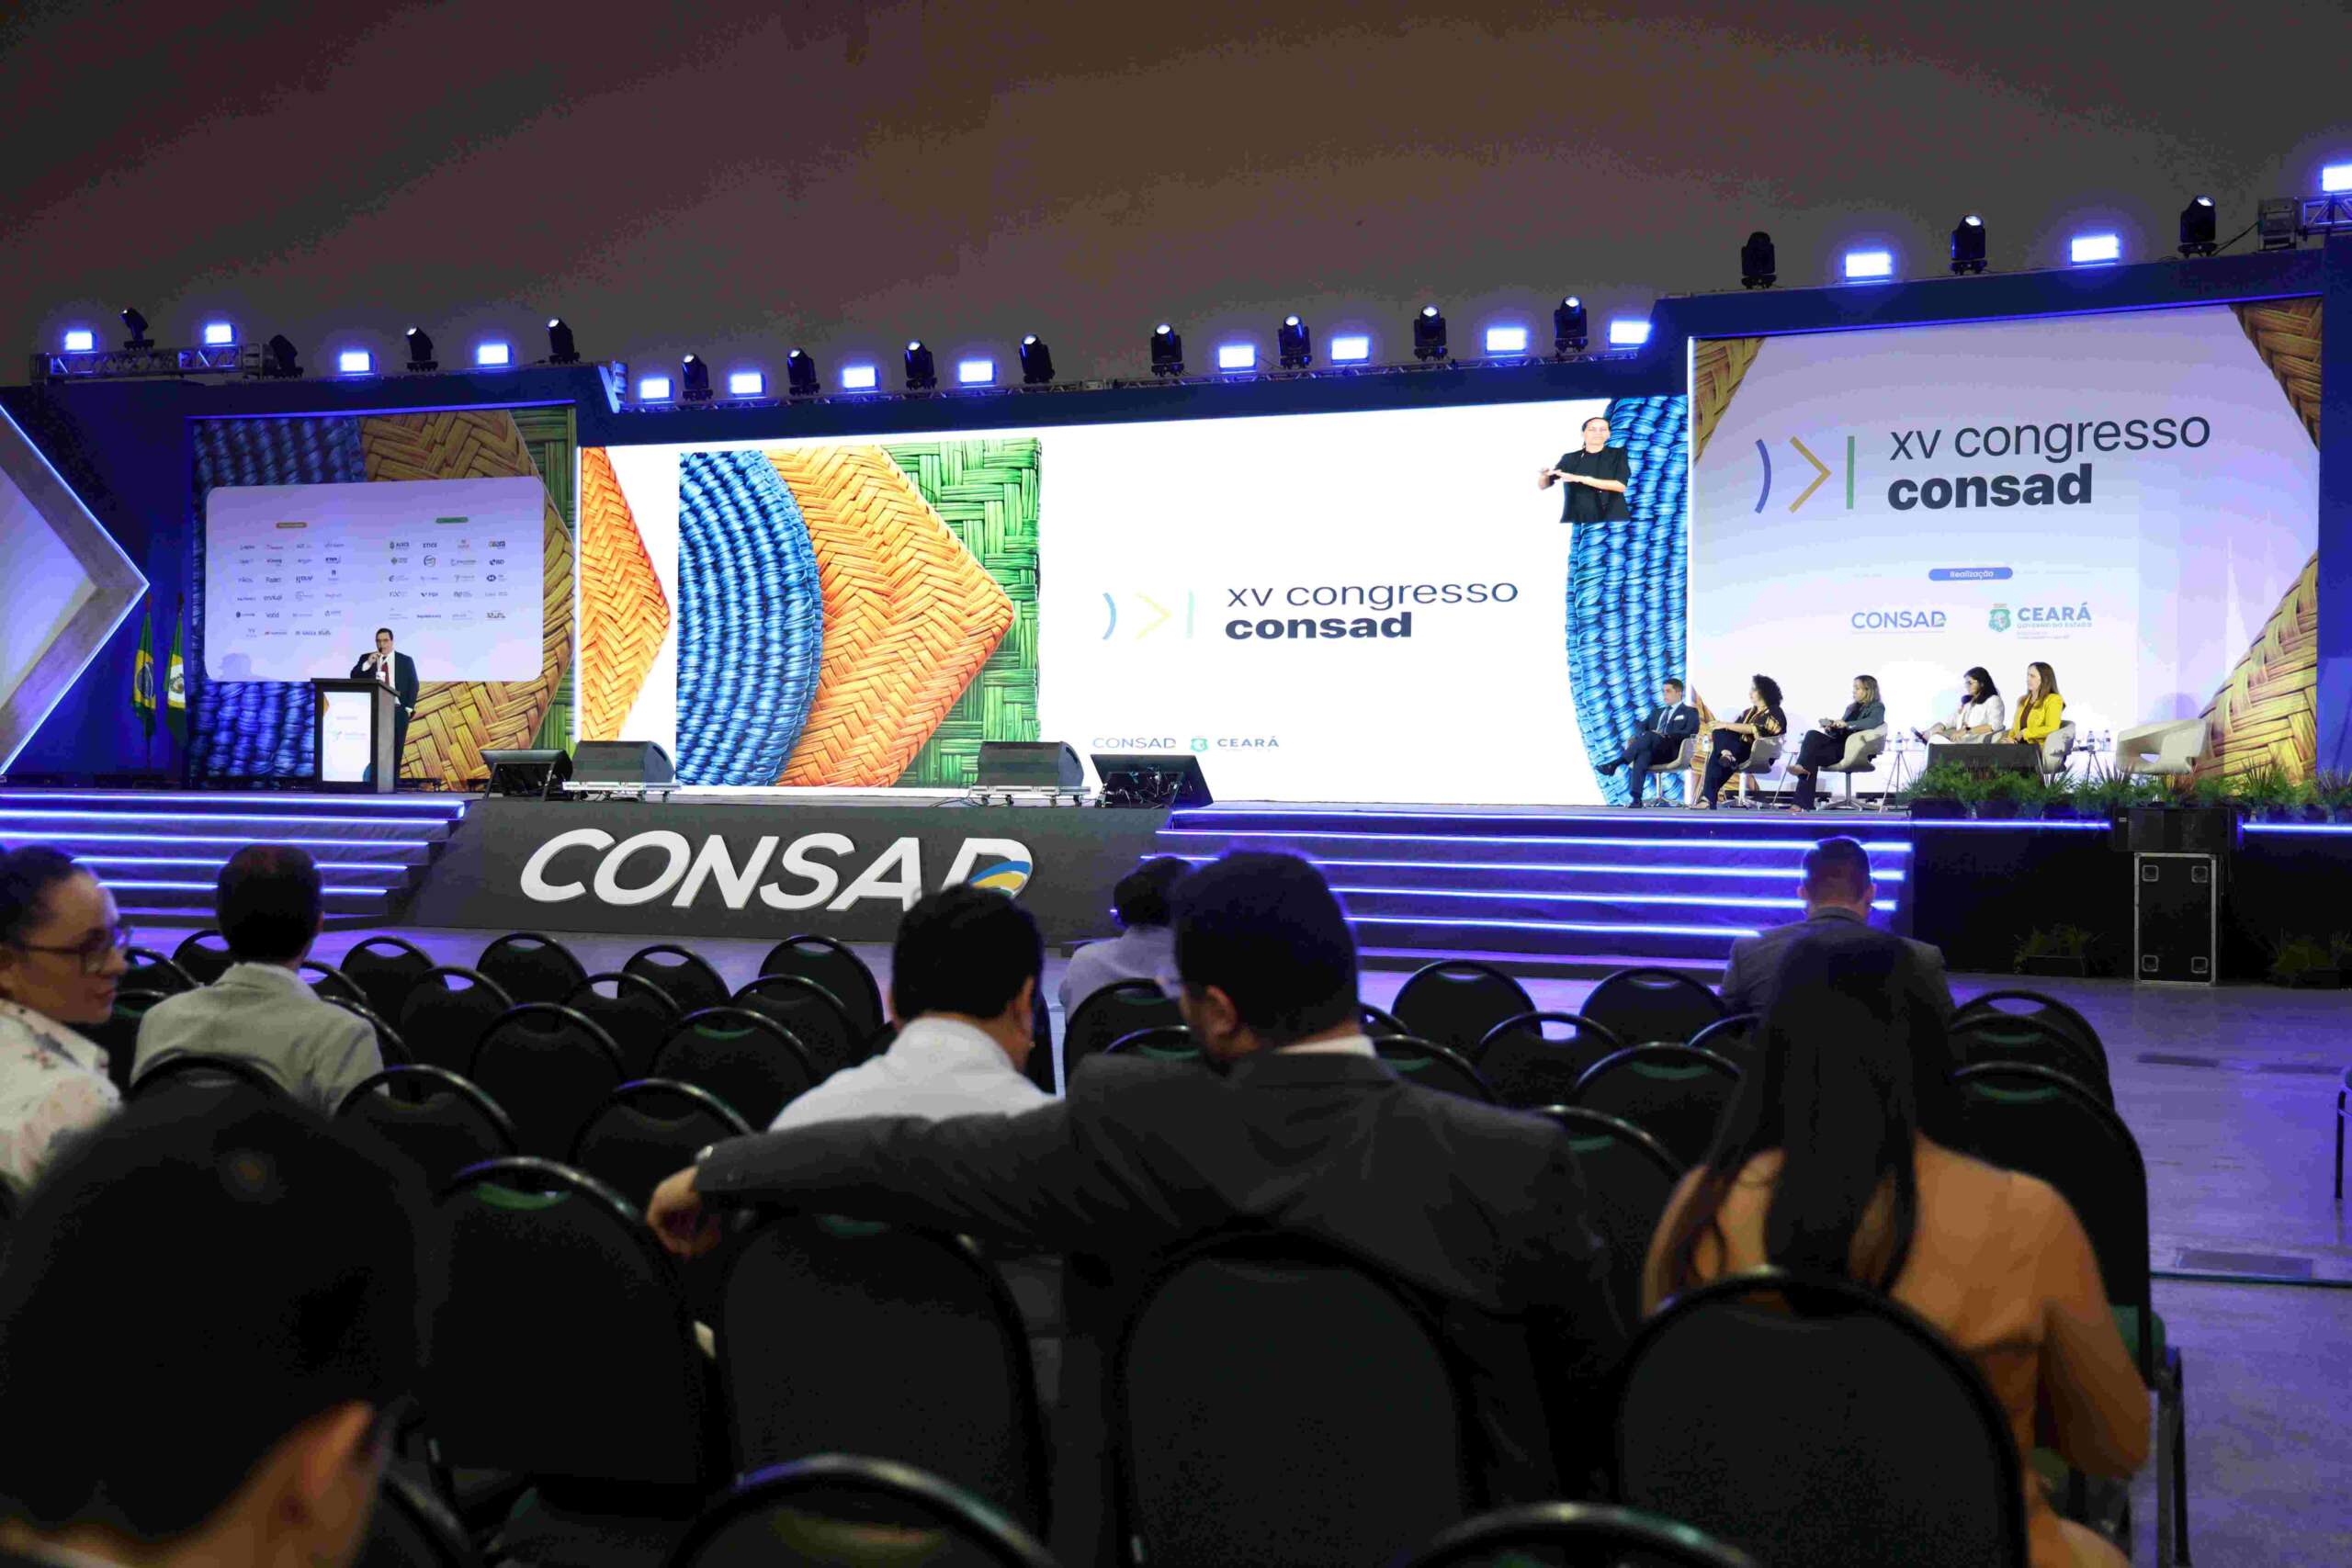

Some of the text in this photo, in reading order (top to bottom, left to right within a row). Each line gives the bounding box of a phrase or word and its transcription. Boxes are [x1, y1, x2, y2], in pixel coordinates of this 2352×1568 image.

[1954, 416, 2211, 464] congresso
[1887, 463, 2093, 511] consad
[1950, 570, 1994, 581] Realização
[1286, 582, 1519, 611] congresso
[1850, 610, 1947, 629] CONSAD
[2017, 601, 2093, 622] CEARÁ
[1225, 611, 1412, 640] consad
[1092, 738, 1177, 749] CONSAD
[1216, 736, 1280, 748] CEARÁ
[520, 828, 1034, 911] CONSAD
